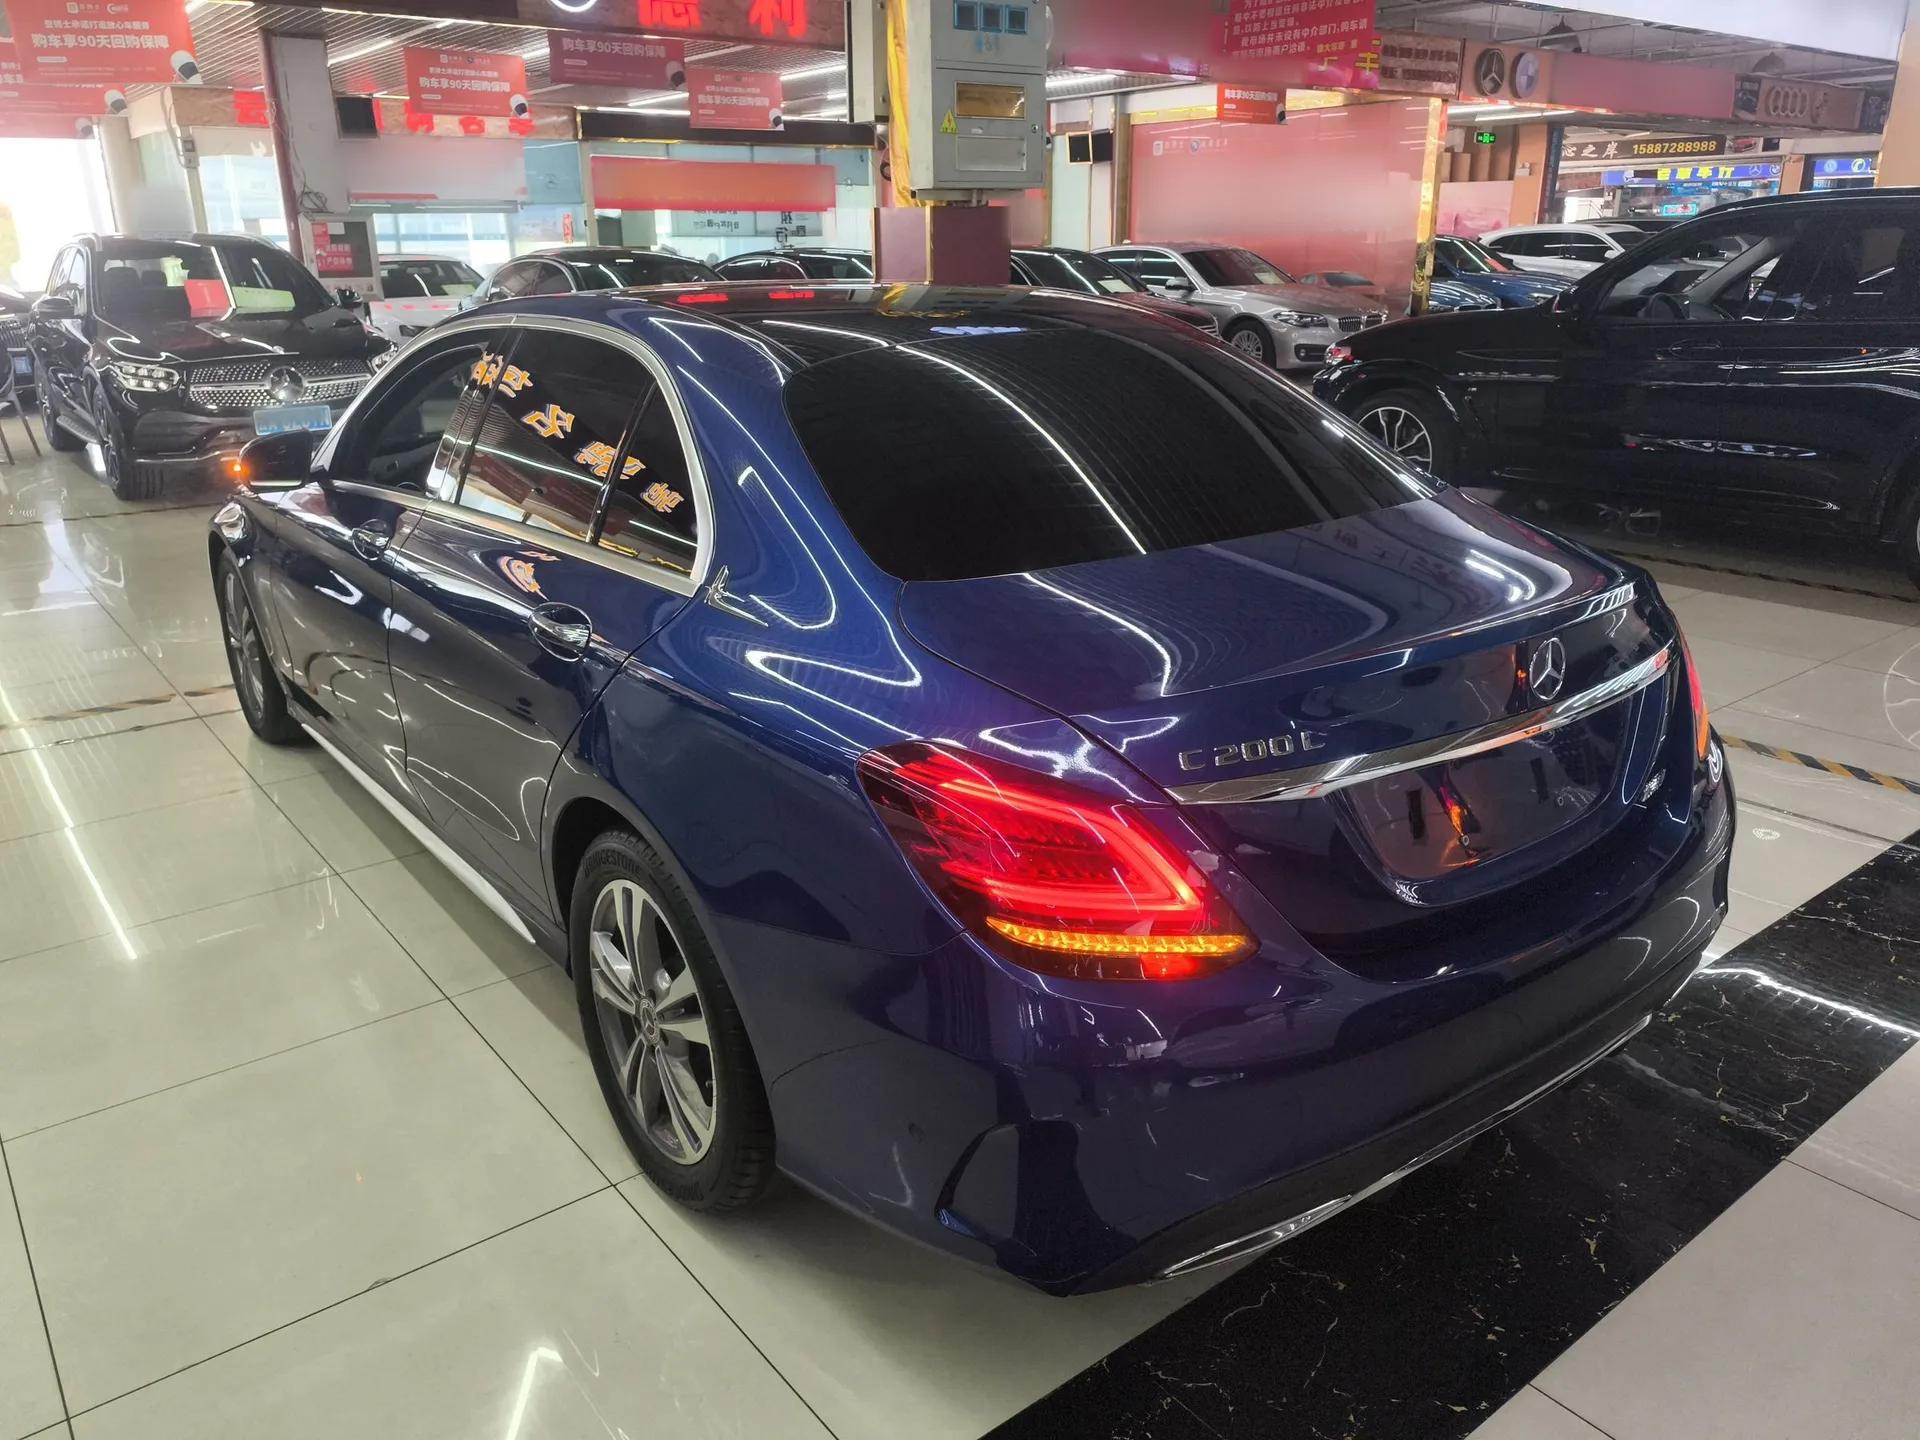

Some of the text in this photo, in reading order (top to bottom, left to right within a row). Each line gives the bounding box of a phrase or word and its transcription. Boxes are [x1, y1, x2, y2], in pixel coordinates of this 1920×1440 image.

[32, 33, 169, 49] 购车享90天回购保障
[562, 37, 666, 58] 购车享90天回购保障
[419, 76, 511, 93] 购车享90天回购保障
[1632, 140, 1717, 155] 15887288988
[1178, 748, 1206, 771] C
[1213, 734, 1295, 766] 200
